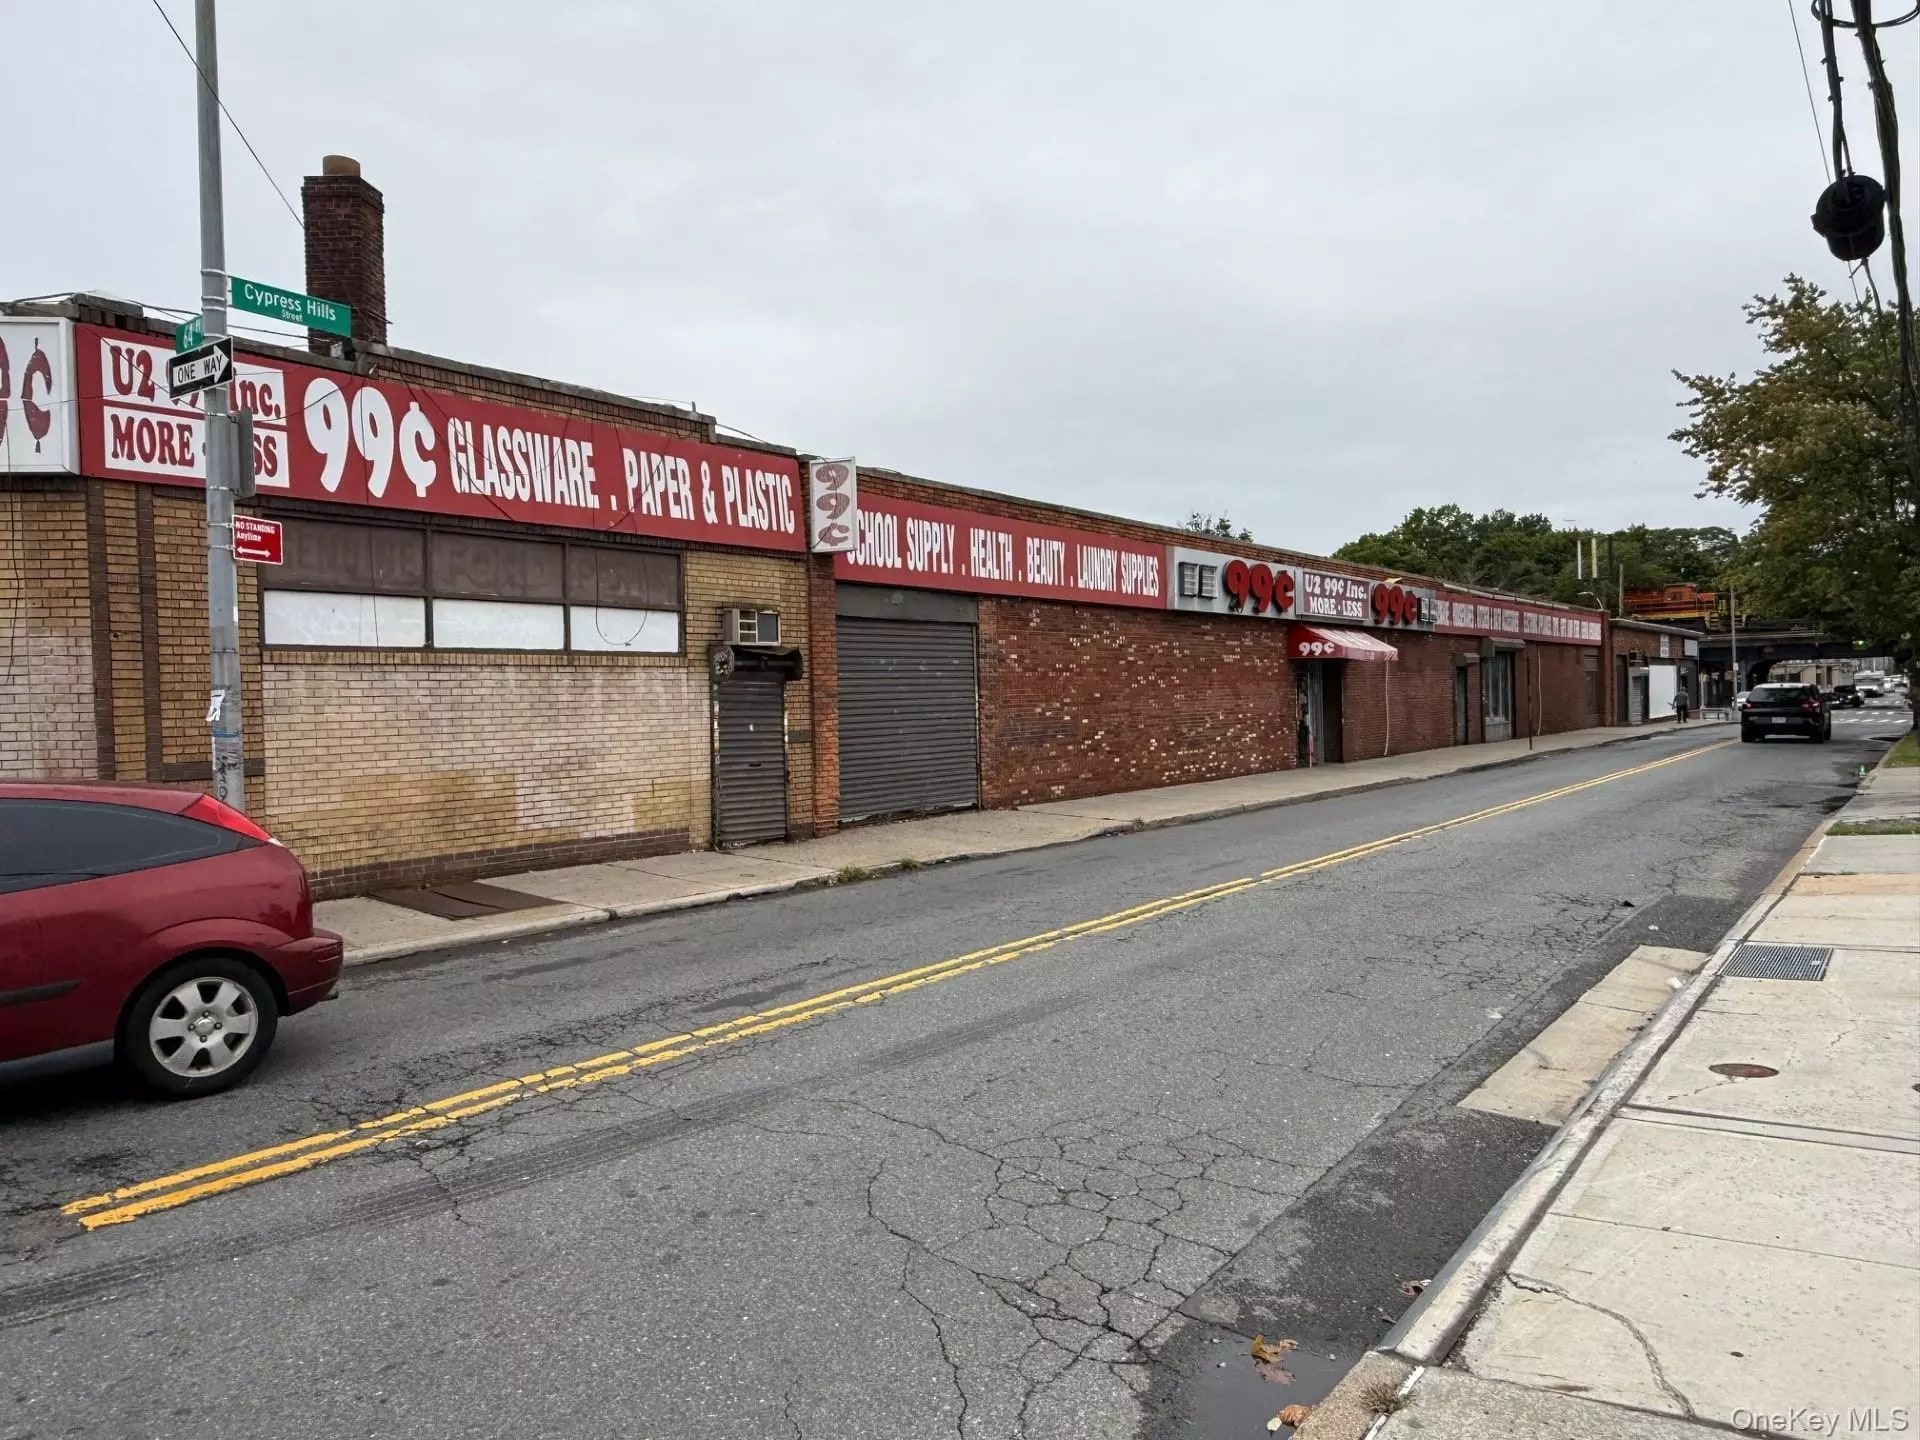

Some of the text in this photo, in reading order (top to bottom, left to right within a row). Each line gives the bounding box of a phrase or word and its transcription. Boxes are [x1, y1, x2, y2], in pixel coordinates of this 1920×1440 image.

[244, 284, 336, 321] Cypress Hills
[281, 309, 303, 322] Street
[110, 345, 281, 419] U2 Inc.
[177, 355, 223, 384] ONE WAY
[110, 413, 195, 468] MORE
[304, 377, 436, 498] 99¢
[448, 417, 600, 509] GLASSWARE
[622, 447, 695, 520] PAPER
[700, 460, 719, 524] &
[721, 464, 795, 534] PLASTIC
[235, 520, 276, 535] NO STANDING
[236, 530, 262, 542] Anytime
[906, 517, 955, 575] SUPPLY
[970, 527, 1013, 581] HEALTH
[1026, 537, 1065, 587] BEAUTY
[1077, 544, 1117, 592] LAUNDRY
[1120, 552, 1159, 598] SUPPLIES
[1222, 559, 1294, 615] 99¢
[1304, 573, 1367, 599] U2 99¢ Inc.
[1309, 596, 1337, 615] MORE
[1342, 600, 1363, 618] LESS
